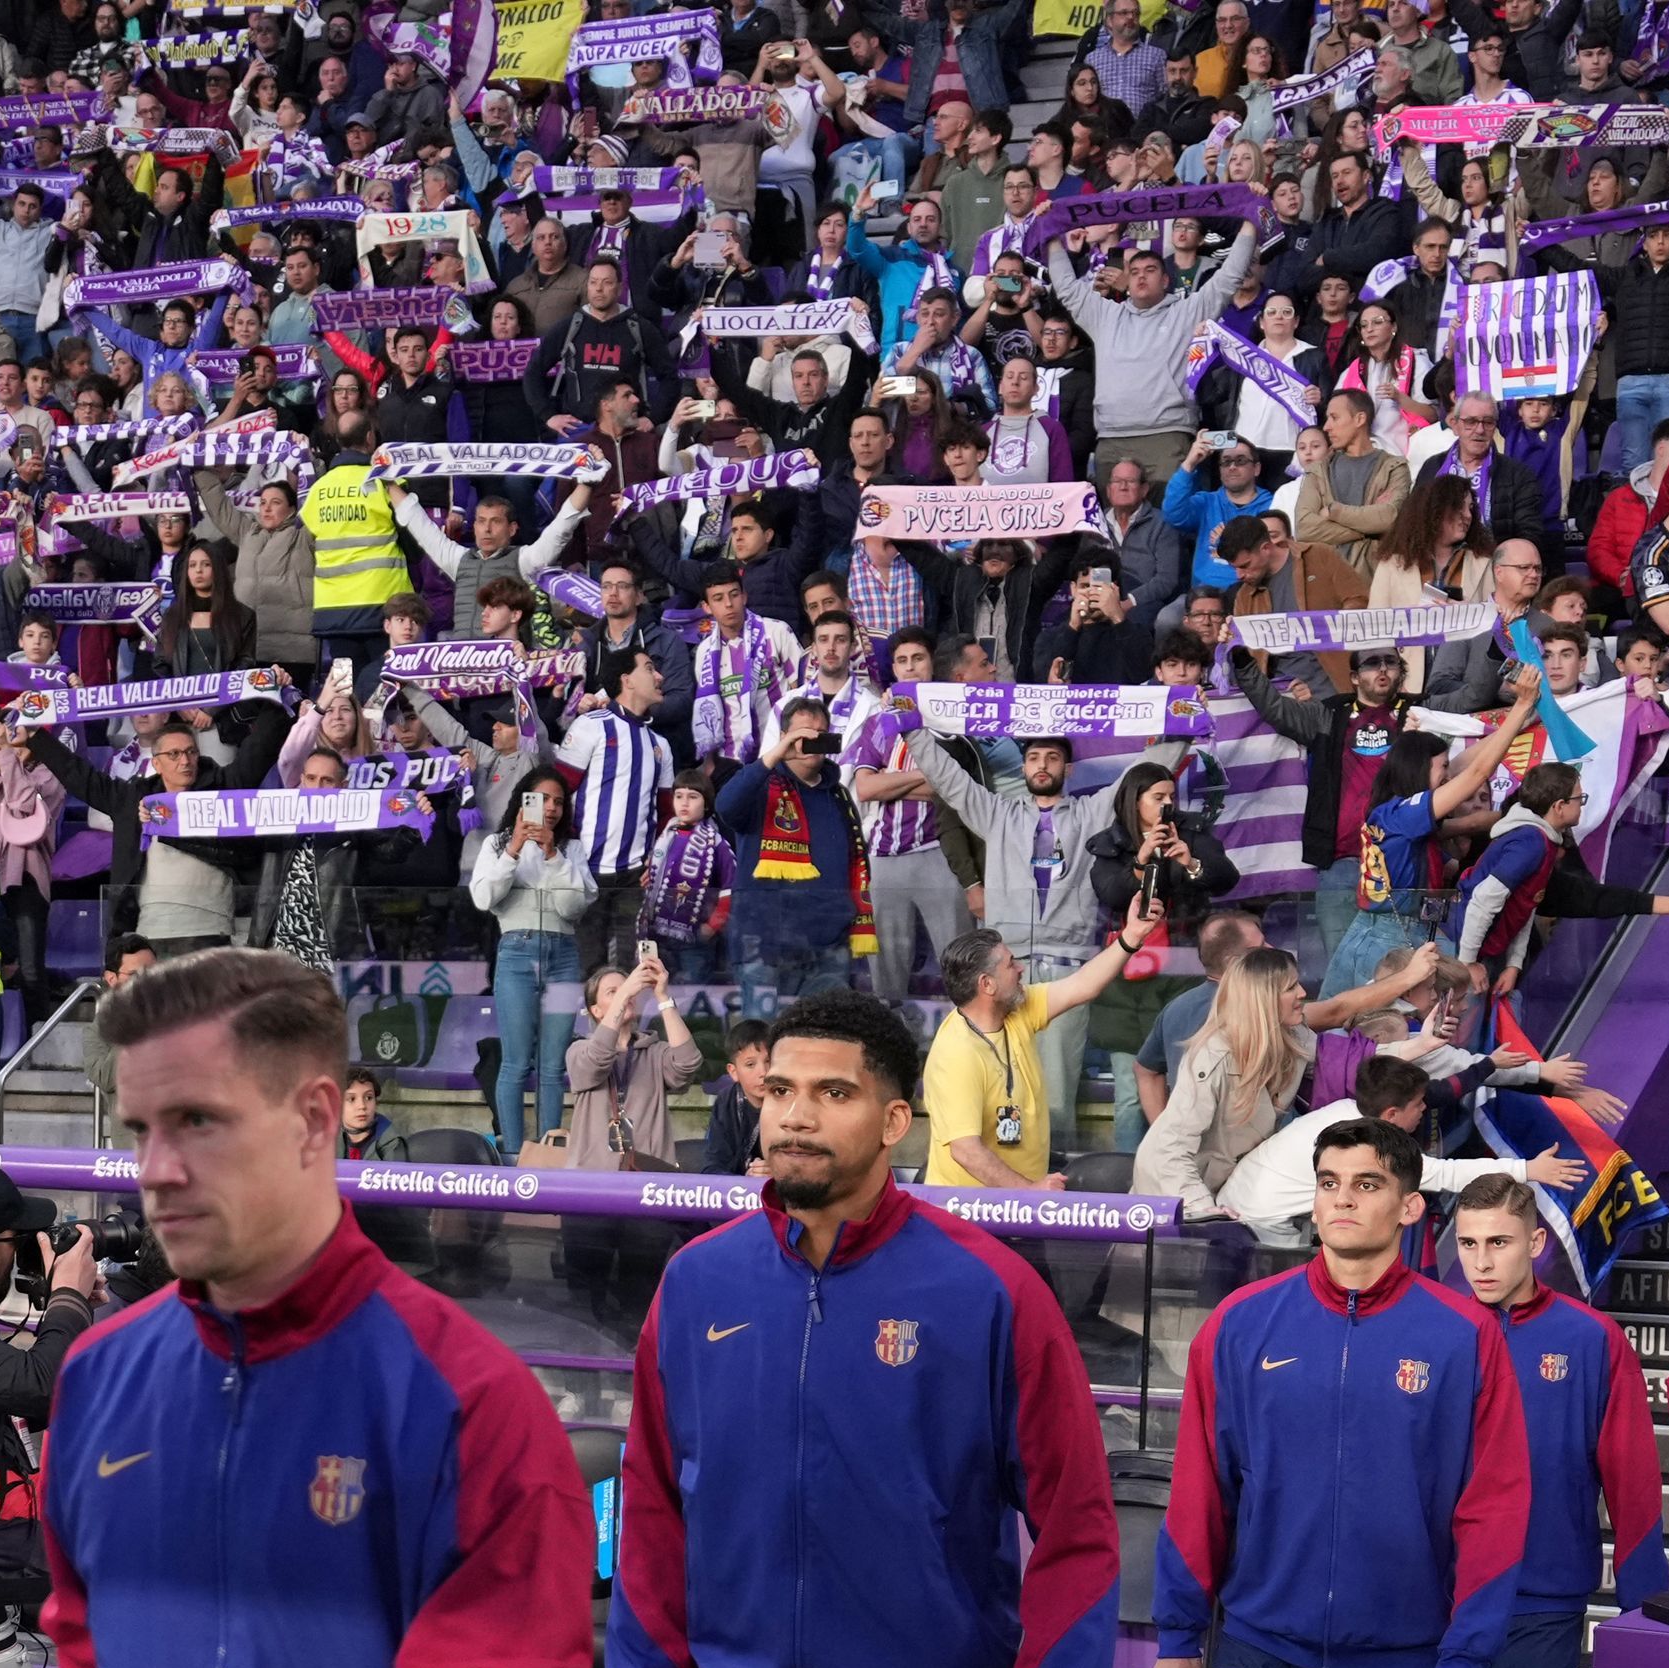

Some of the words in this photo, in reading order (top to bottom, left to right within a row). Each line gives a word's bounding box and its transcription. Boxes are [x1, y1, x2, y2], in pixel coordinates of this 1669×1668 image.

[1408, 117, 1459, 132] MUJER
[554, 171, 586, 187] CLUB
[589, 171, 608, 187] DE
[1067, 187, 1228, 226] PUCELA
[386, 213, 449, 237] 1928
[88, 278, 120, 292] REAL
[122, 270, 197, 288] VALLADOLID
[583, 343, 621, 364] HH
[391, 445, 432, 464] REAL
[449, 443, 576, 464] VALLADOLID
[318, 482, 369, 501] EULEN
[916, 489, 958, 502] REAL
[960, 486, 1055, 501] VALLADOLID
[74, 493, 129, 515] REAL
[319, 503, 367, 523] SEGURIDAD
[998, 500, 1068, 531] GIRLS
[567, 584, 603, 611] REAL
[1252, 615, 1322, 648] REAL
[1330, 603, 1493, 644] VALLADOLID
[76, 684, 130, 710] REAL
[132, 672, 221, 704] VALLADOLID
[964, 686, 1006, 699] Peña
[929, 700, 1001, 720] VILLA
[1009, 701, 1040, 719] DE
[1050, 697, 1155, 720] CUÉLLAR
[1356, 728, 1389, 741] Estrella
[1357, 738, 1388, 750] Galicia
[187, 796, 243, 829] REAL
[244, 791, 370, 828] VALLADOLID
[357, 1166, 436, 1194] Estrella
[438, 1170, 511, 1198] Galicia
[640, 1181, 724, 1209] Estrella
[1036, 1200, 1121, 1230] Galicia
